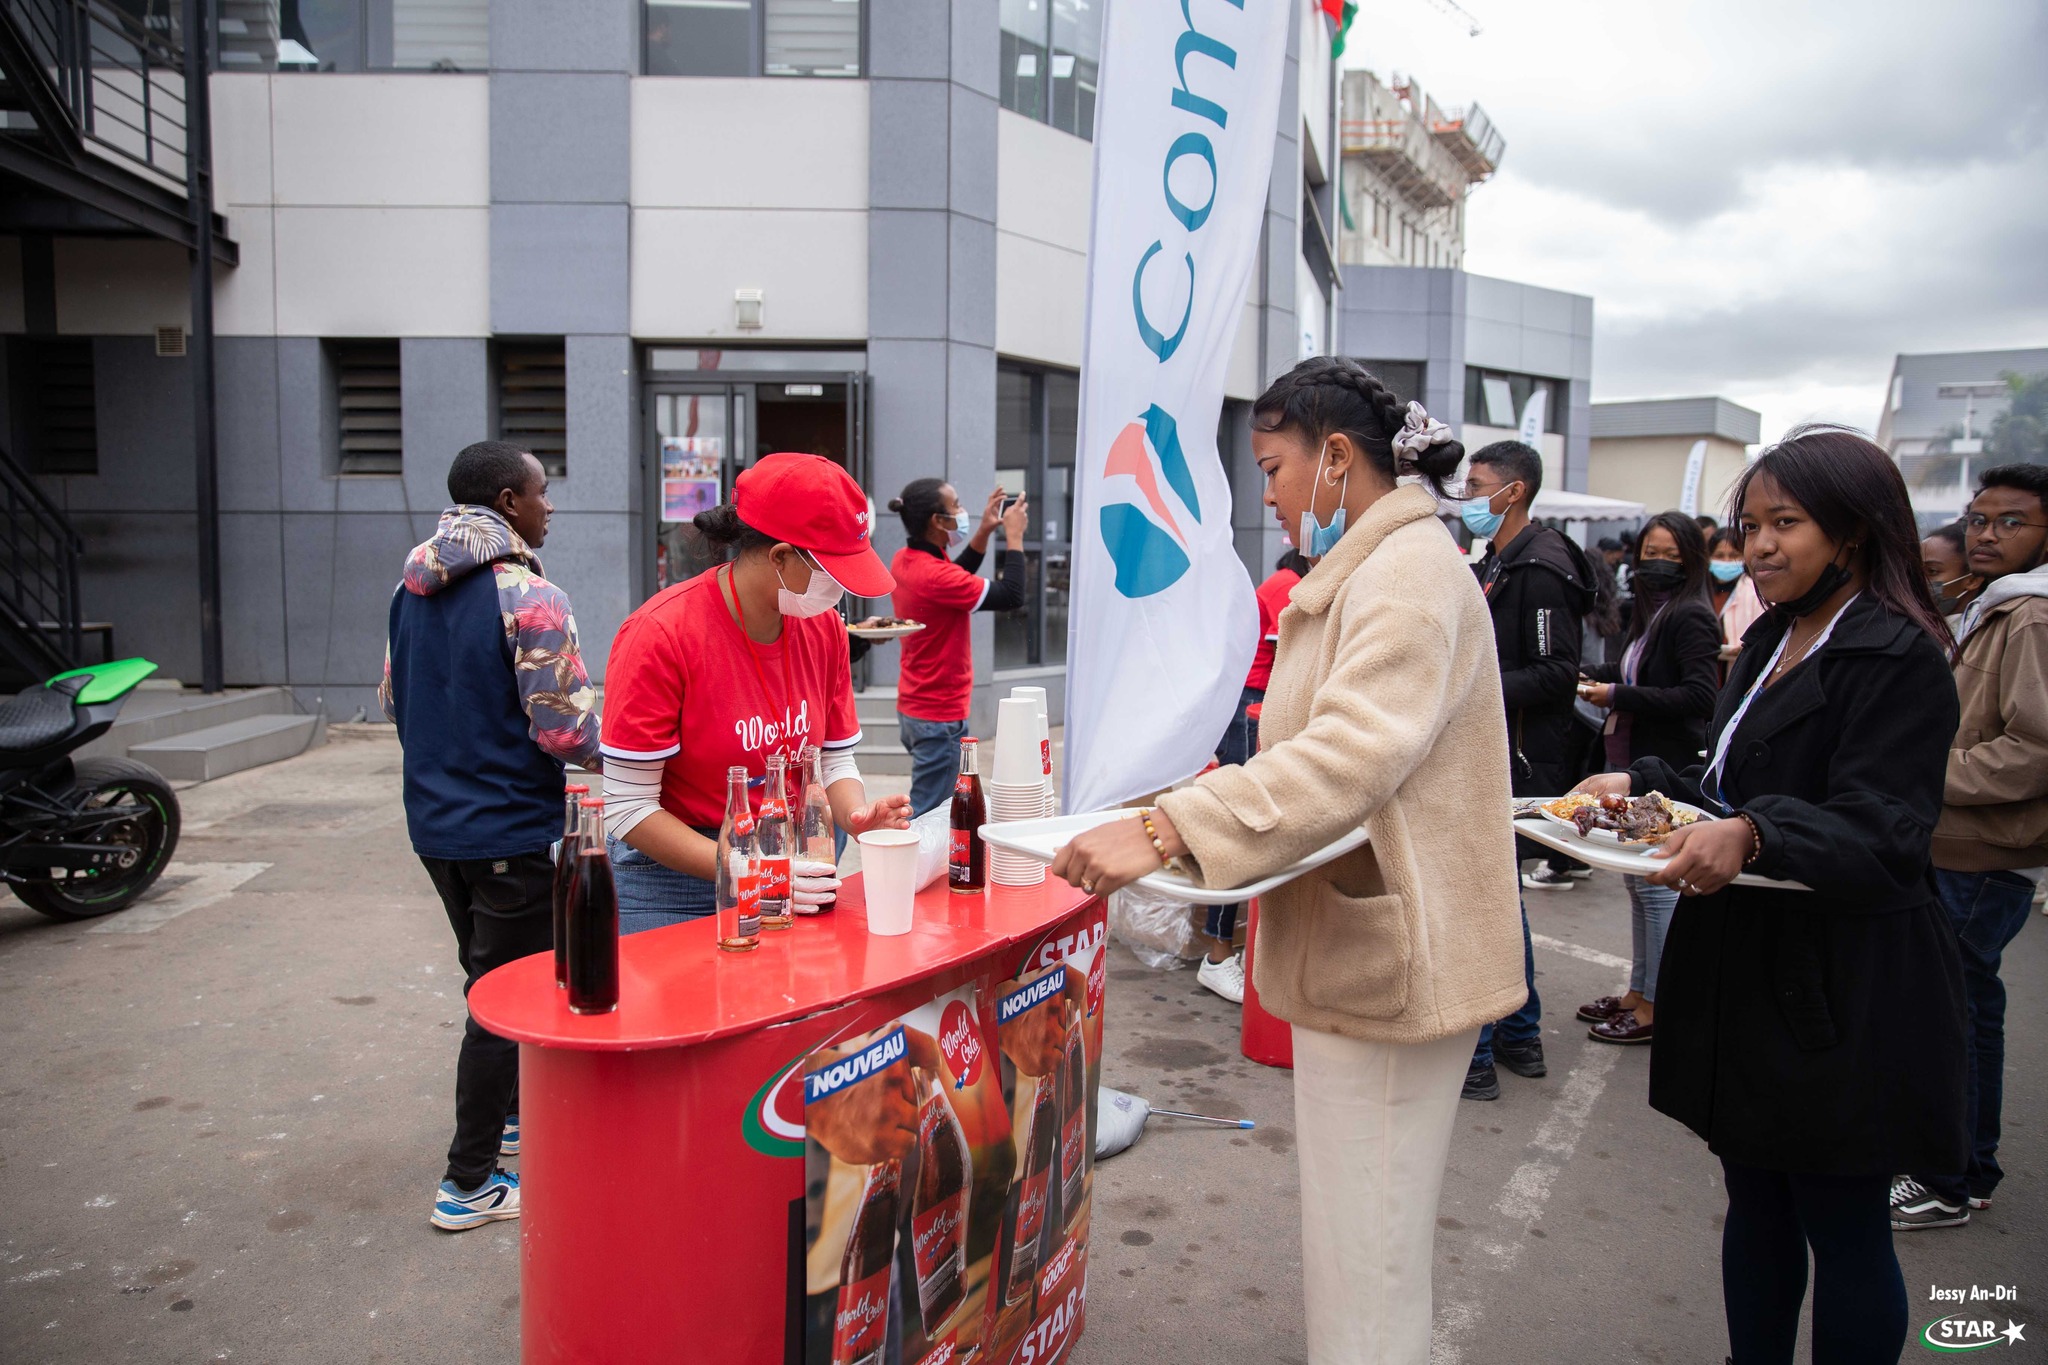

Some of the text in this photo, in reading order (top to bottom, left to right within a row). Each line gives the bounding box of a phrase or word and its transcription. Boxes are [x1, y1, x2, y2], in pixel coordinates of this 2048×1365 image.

[770, 872, 788, 885] Cola
[1002, 969, 1065, 1020] NOUVEAU
[941, 1009, 970, 1059] World
[960, 1034, 981, 1064] Cola
[812, 1032, 905, 1098] NOUVEAU
[916, 1209, 947, 1254] World
[836, 1291, 885, 1332] World Cola
[1021, 1286, 1077, 1365] STAR
